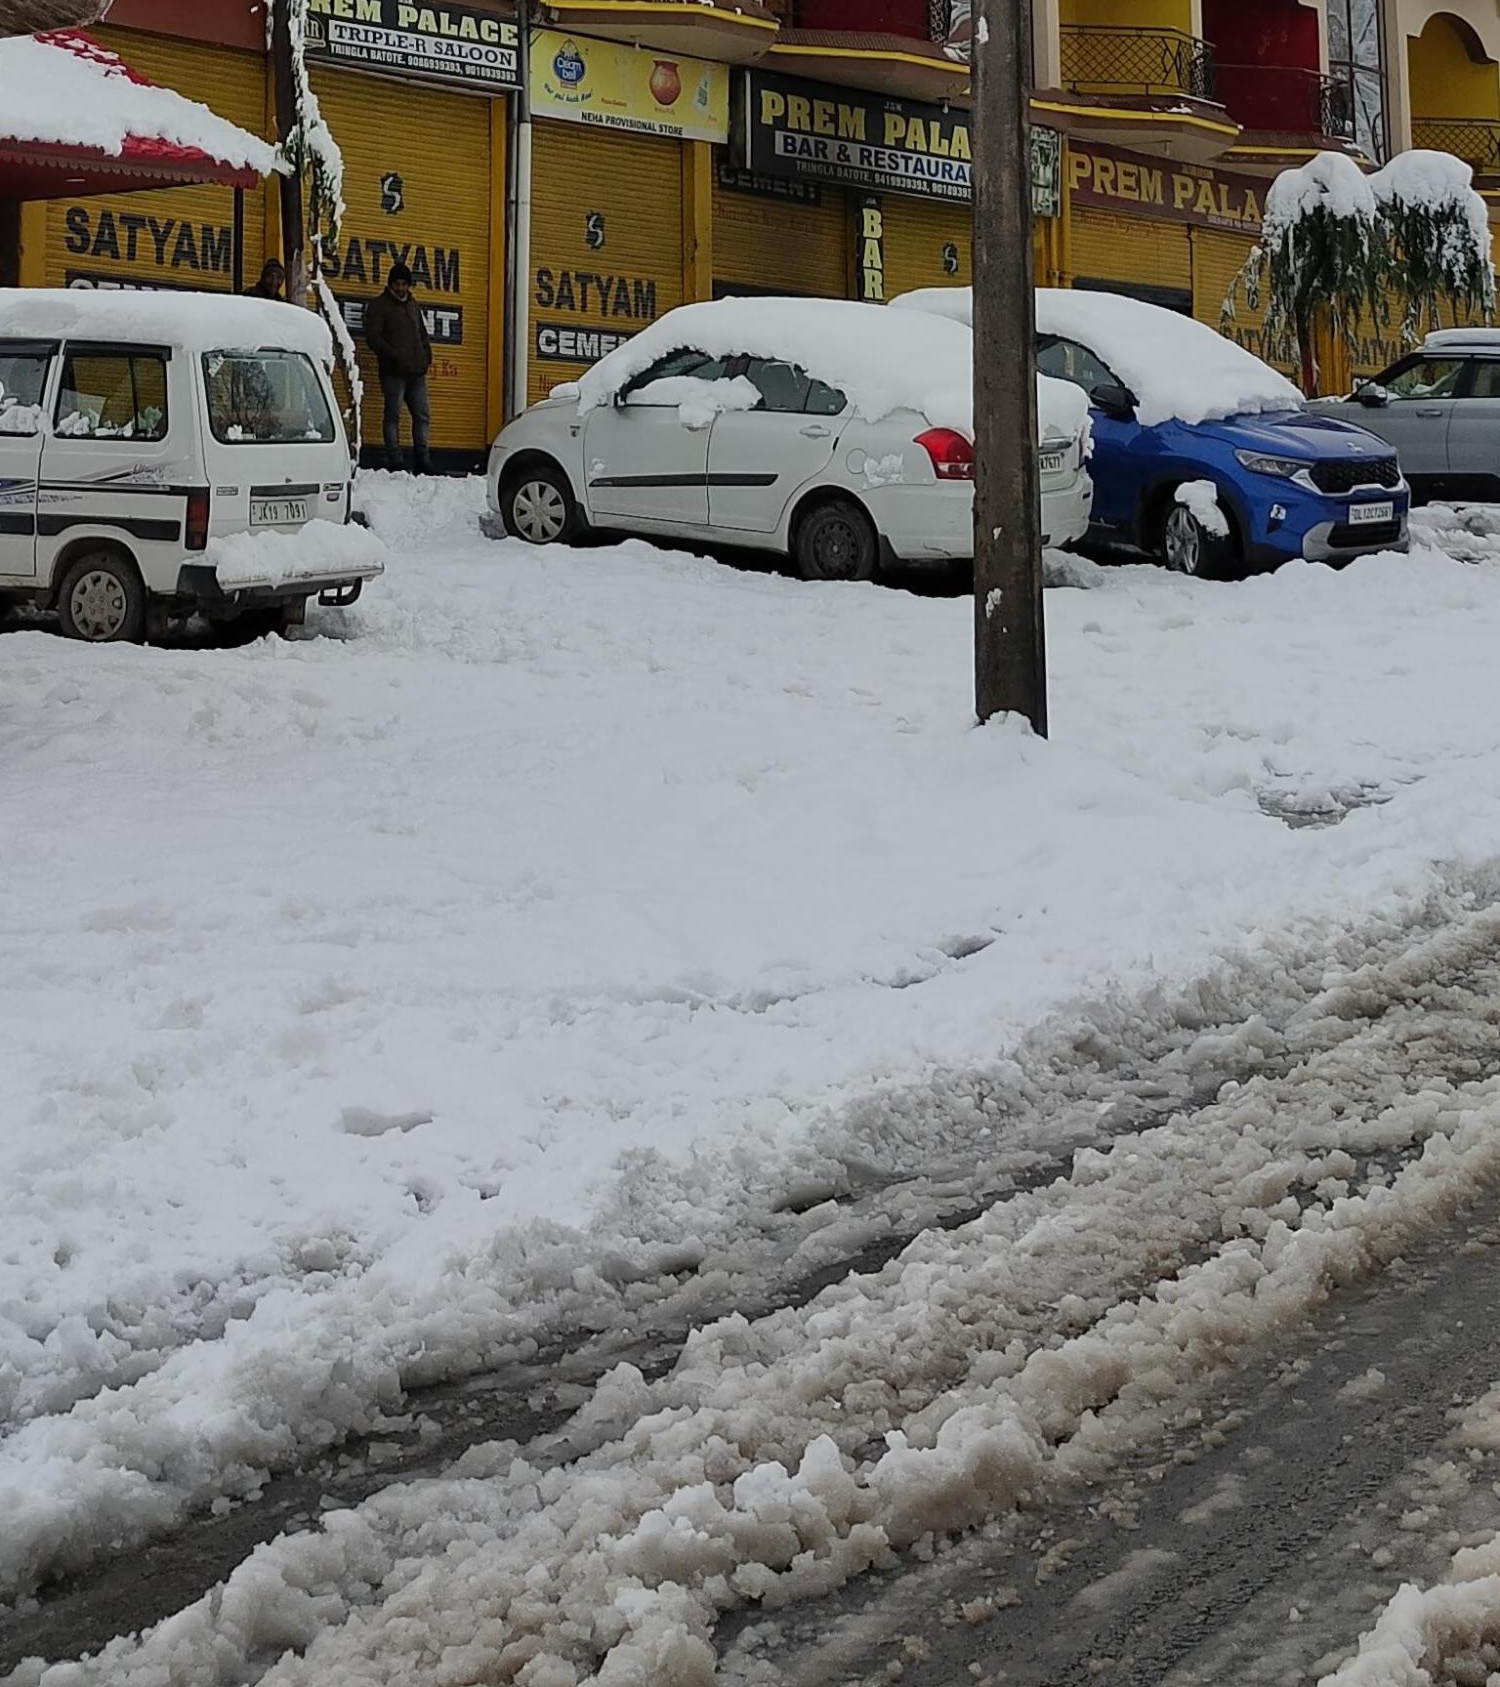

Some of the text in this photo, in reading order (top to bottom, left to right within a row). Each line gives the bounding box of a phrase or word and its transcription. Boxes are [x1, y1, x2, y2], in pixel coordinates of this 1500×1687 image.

[334, 24, 513, 67] TRIPLE-R SALOON
[398, 4, 519, 47] PALACE
[330, 43, 369, 60] TRINGLA
[581, 111, 683, 136] NEHA PROVISIONAL STORE
[760, 89, 972, 160] PREM PALA
[782, 134, 971, 185] BAR & RESTAURA
[796, 161, 834, 176] TRINGLA
[1068, 151, 1164, 206] PREM
[1172, 173, 1264, 224] PALA
[65, 205, 232, 272] SATYAM
[861, 207, 885, 300] BAR
[535, 267, 656, 320] SATYAM
[538, 329, 629, 357] CEME
[258, 500, 306, 521] JK19 7091
